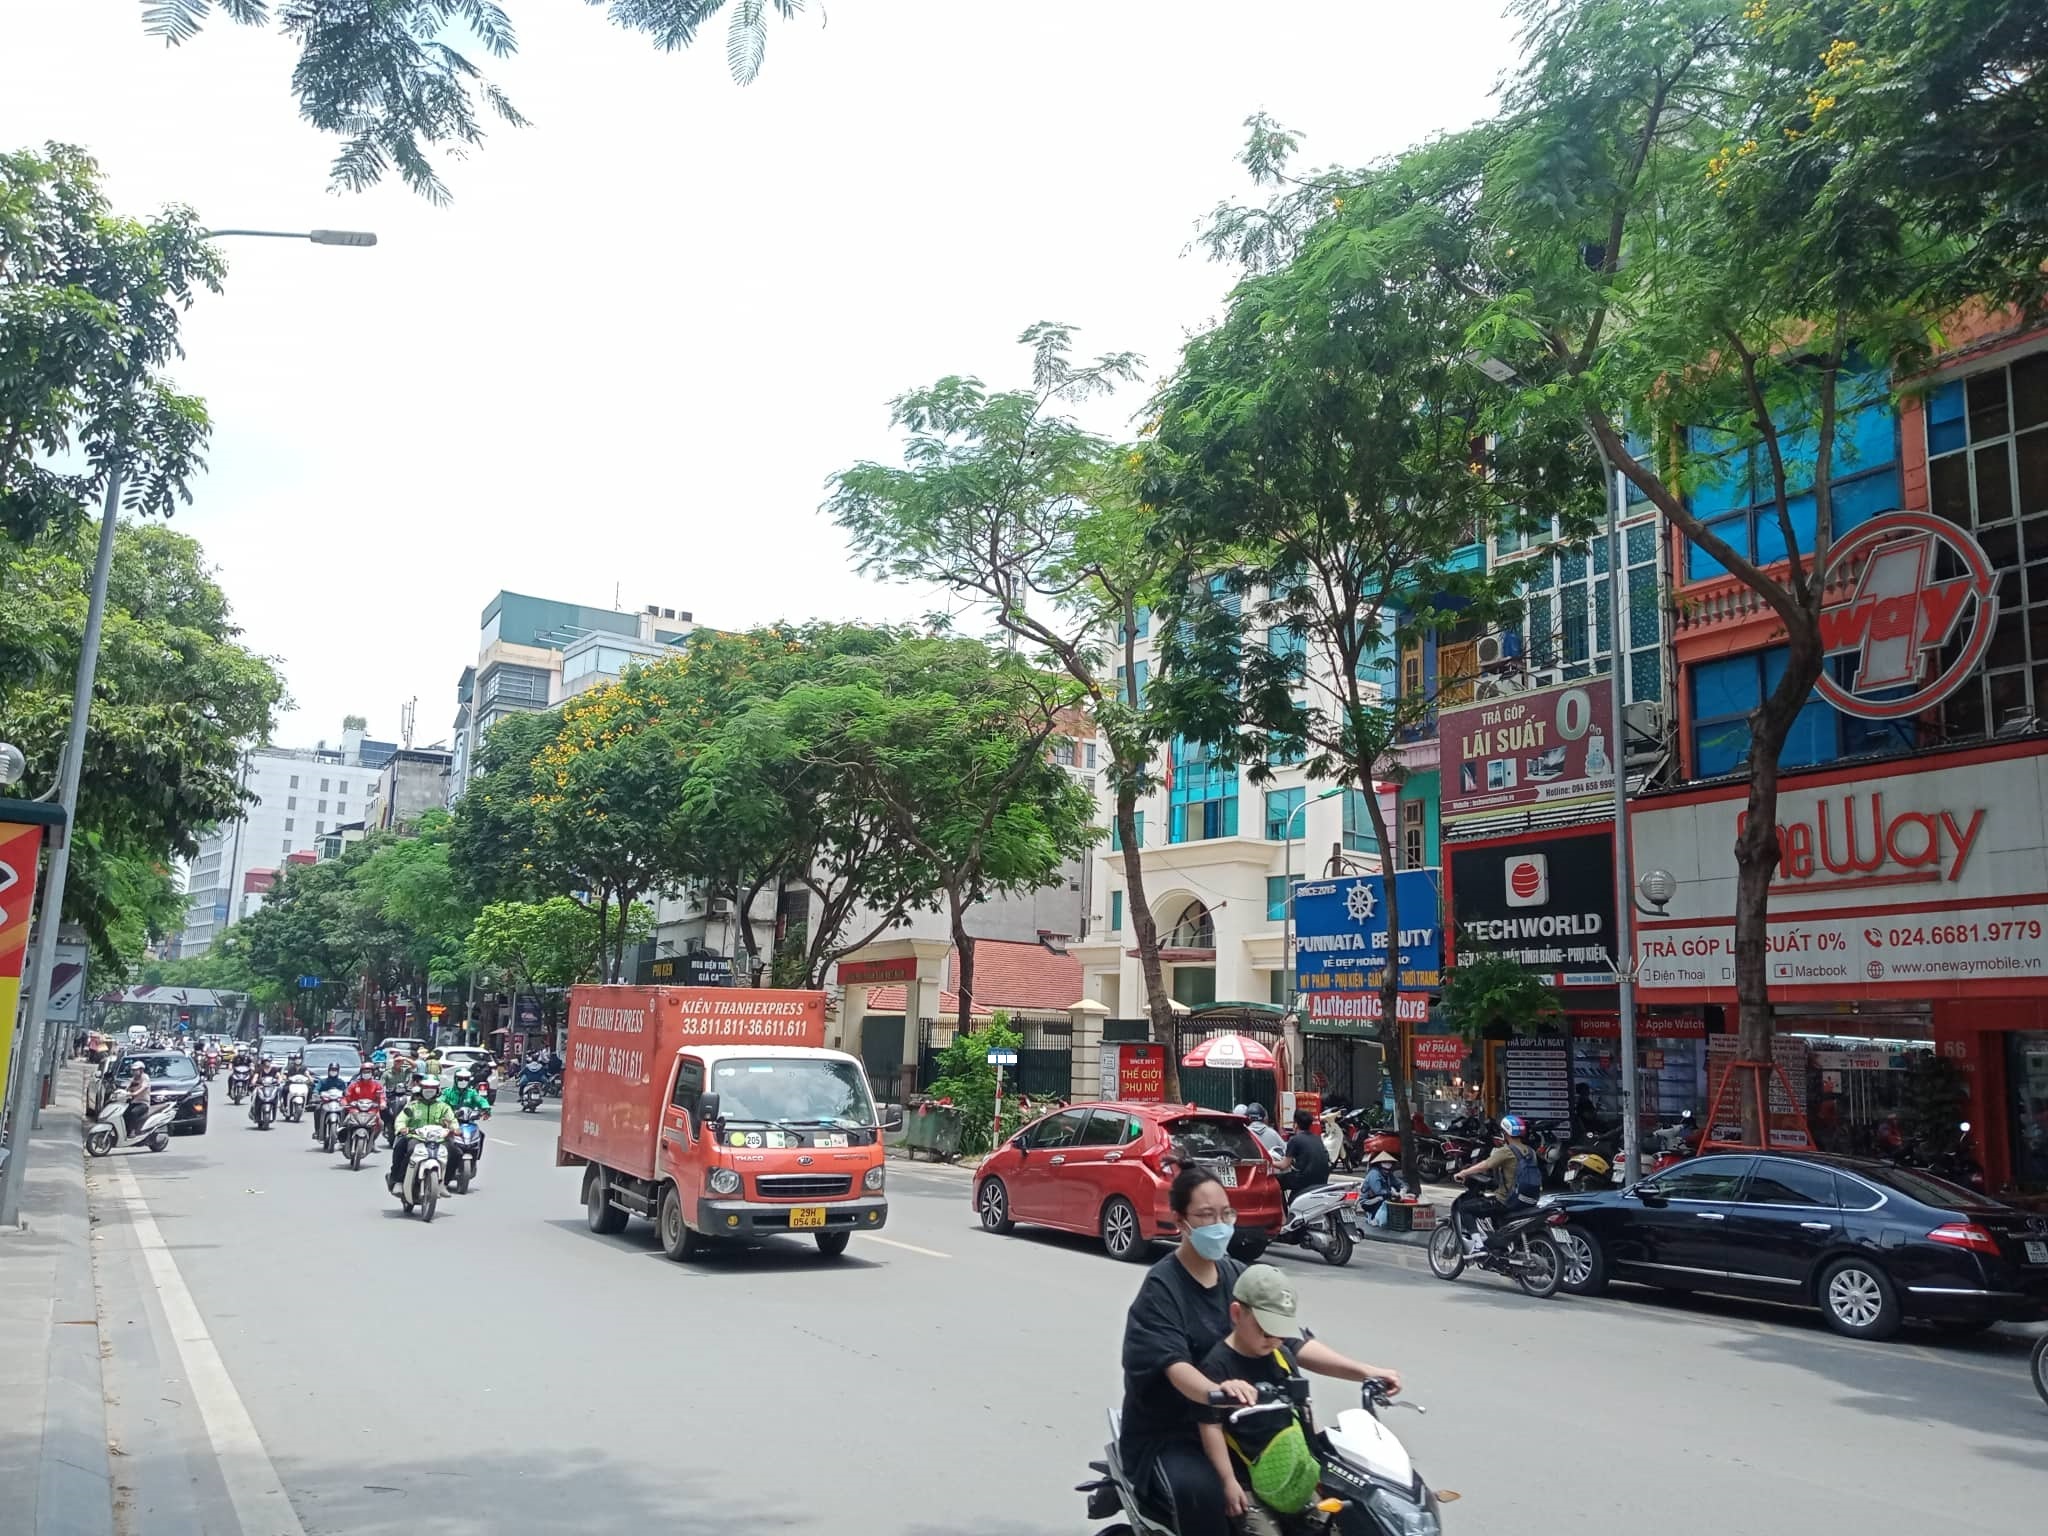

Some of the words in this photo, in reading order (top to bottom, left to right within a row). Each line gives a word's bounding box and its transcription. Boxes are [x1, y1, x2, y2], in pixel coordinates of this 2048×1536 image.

[1482, 706, 1501, 726] TRẢ
[1504, 704, 1526, 722] GÓP
[1462, 729, 1491, 759] LÃI
[1497, 714, 1547, 753] SUẤT
[1737, 790, 1985, 881] neWay
[1296, 933, 1365, 952] PUNNATA
[1371, 929, 1433, 949] BEUTY
[1817, 932, 1846, 951] 0%
[1889, 920, 2042, 947] 024.6681.9779
[1643, 936, 1677, 957] TRẢ
[1682, 935, 1720, 956] GÓP
[1568, 947, 1584, 964] PHỤ
[1795, 965, 1847, 978] Macbook
[1891, 957, 2042, 974] www.onewaymobile.vn
[1653, 969, 1676, 984] Điện
[1313, 994, 1382, 1018] Authentic
[1396, 995, 1426, 1019] tore
[593, 1006, 614, 1031] THANH
[614, 1009, 645, 1034] EXPRESS
[1646, 1020, 1673, 1031] Apple
[1674, 1019, 1705, 1029] Watch
[1121, 1066, 1139, 1079] THẾ
[1145, 1080, 1159, 1092] NỮ
[747, 1135, 760, 1146] 205
[800, 1208, 816, 1217] 29H
